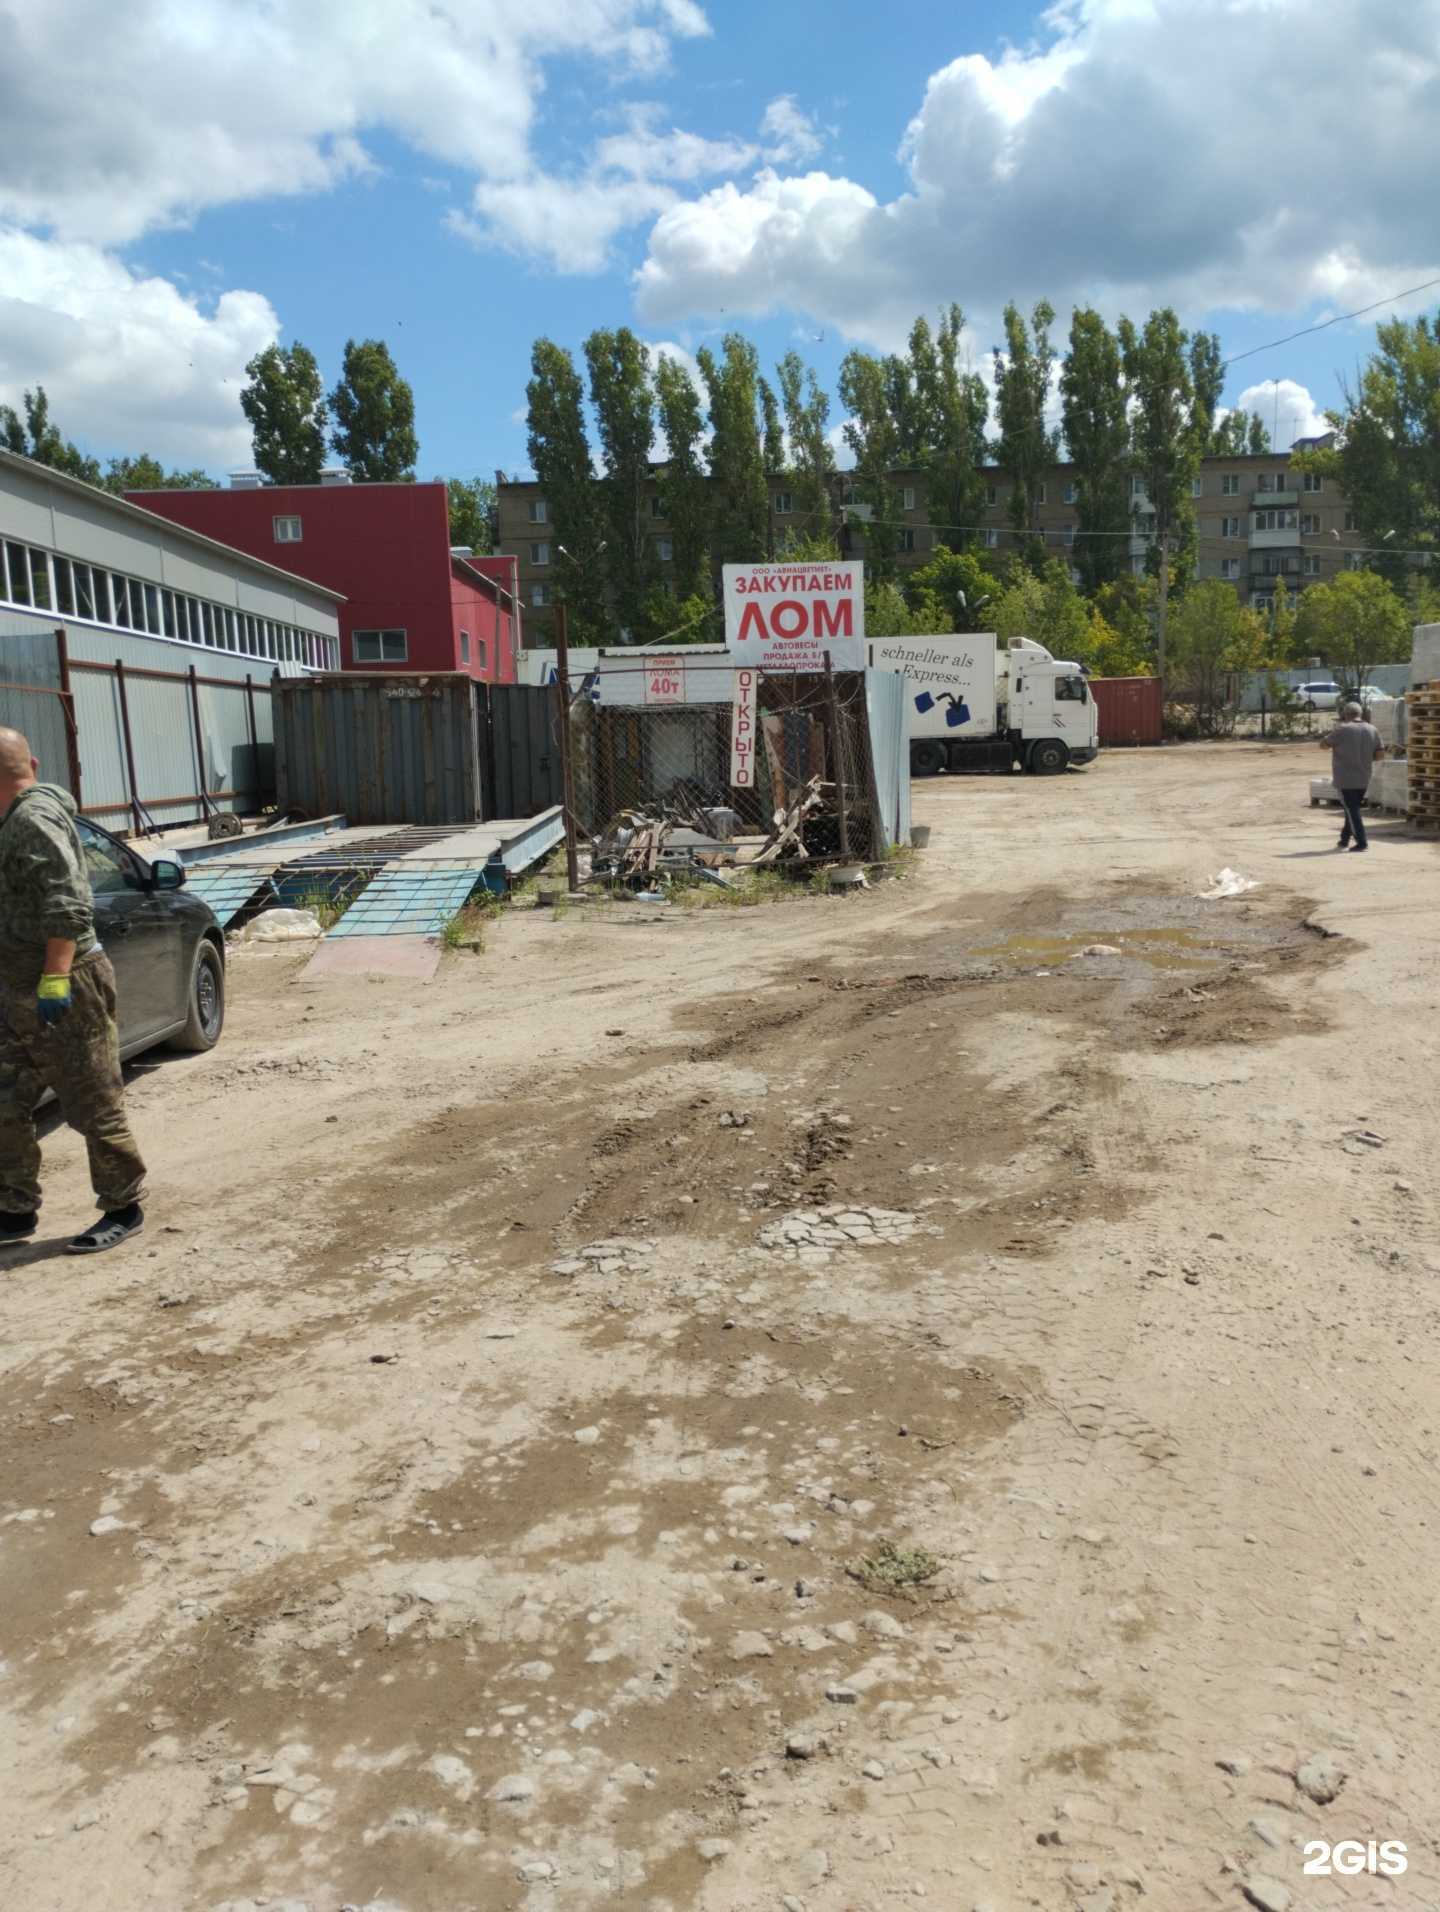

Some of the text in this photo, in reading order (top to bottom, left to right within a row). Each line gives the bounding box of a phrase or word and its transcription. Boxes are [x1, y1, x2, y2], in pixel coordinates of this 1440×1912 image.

[752, 567, 770, 575] ООО
[735, 573, 852, 594] ЗАКУПАЕМ
[737, 598, 853, 641] ЛОМ
[763, 652, 808, 660] ПРОДАЖА
[772, 641, 818, 650] АВТОВЕСЫ
[880, 645, 974, 668] schneller als
[735, 671, 751, 784] ОТКРЫТО
